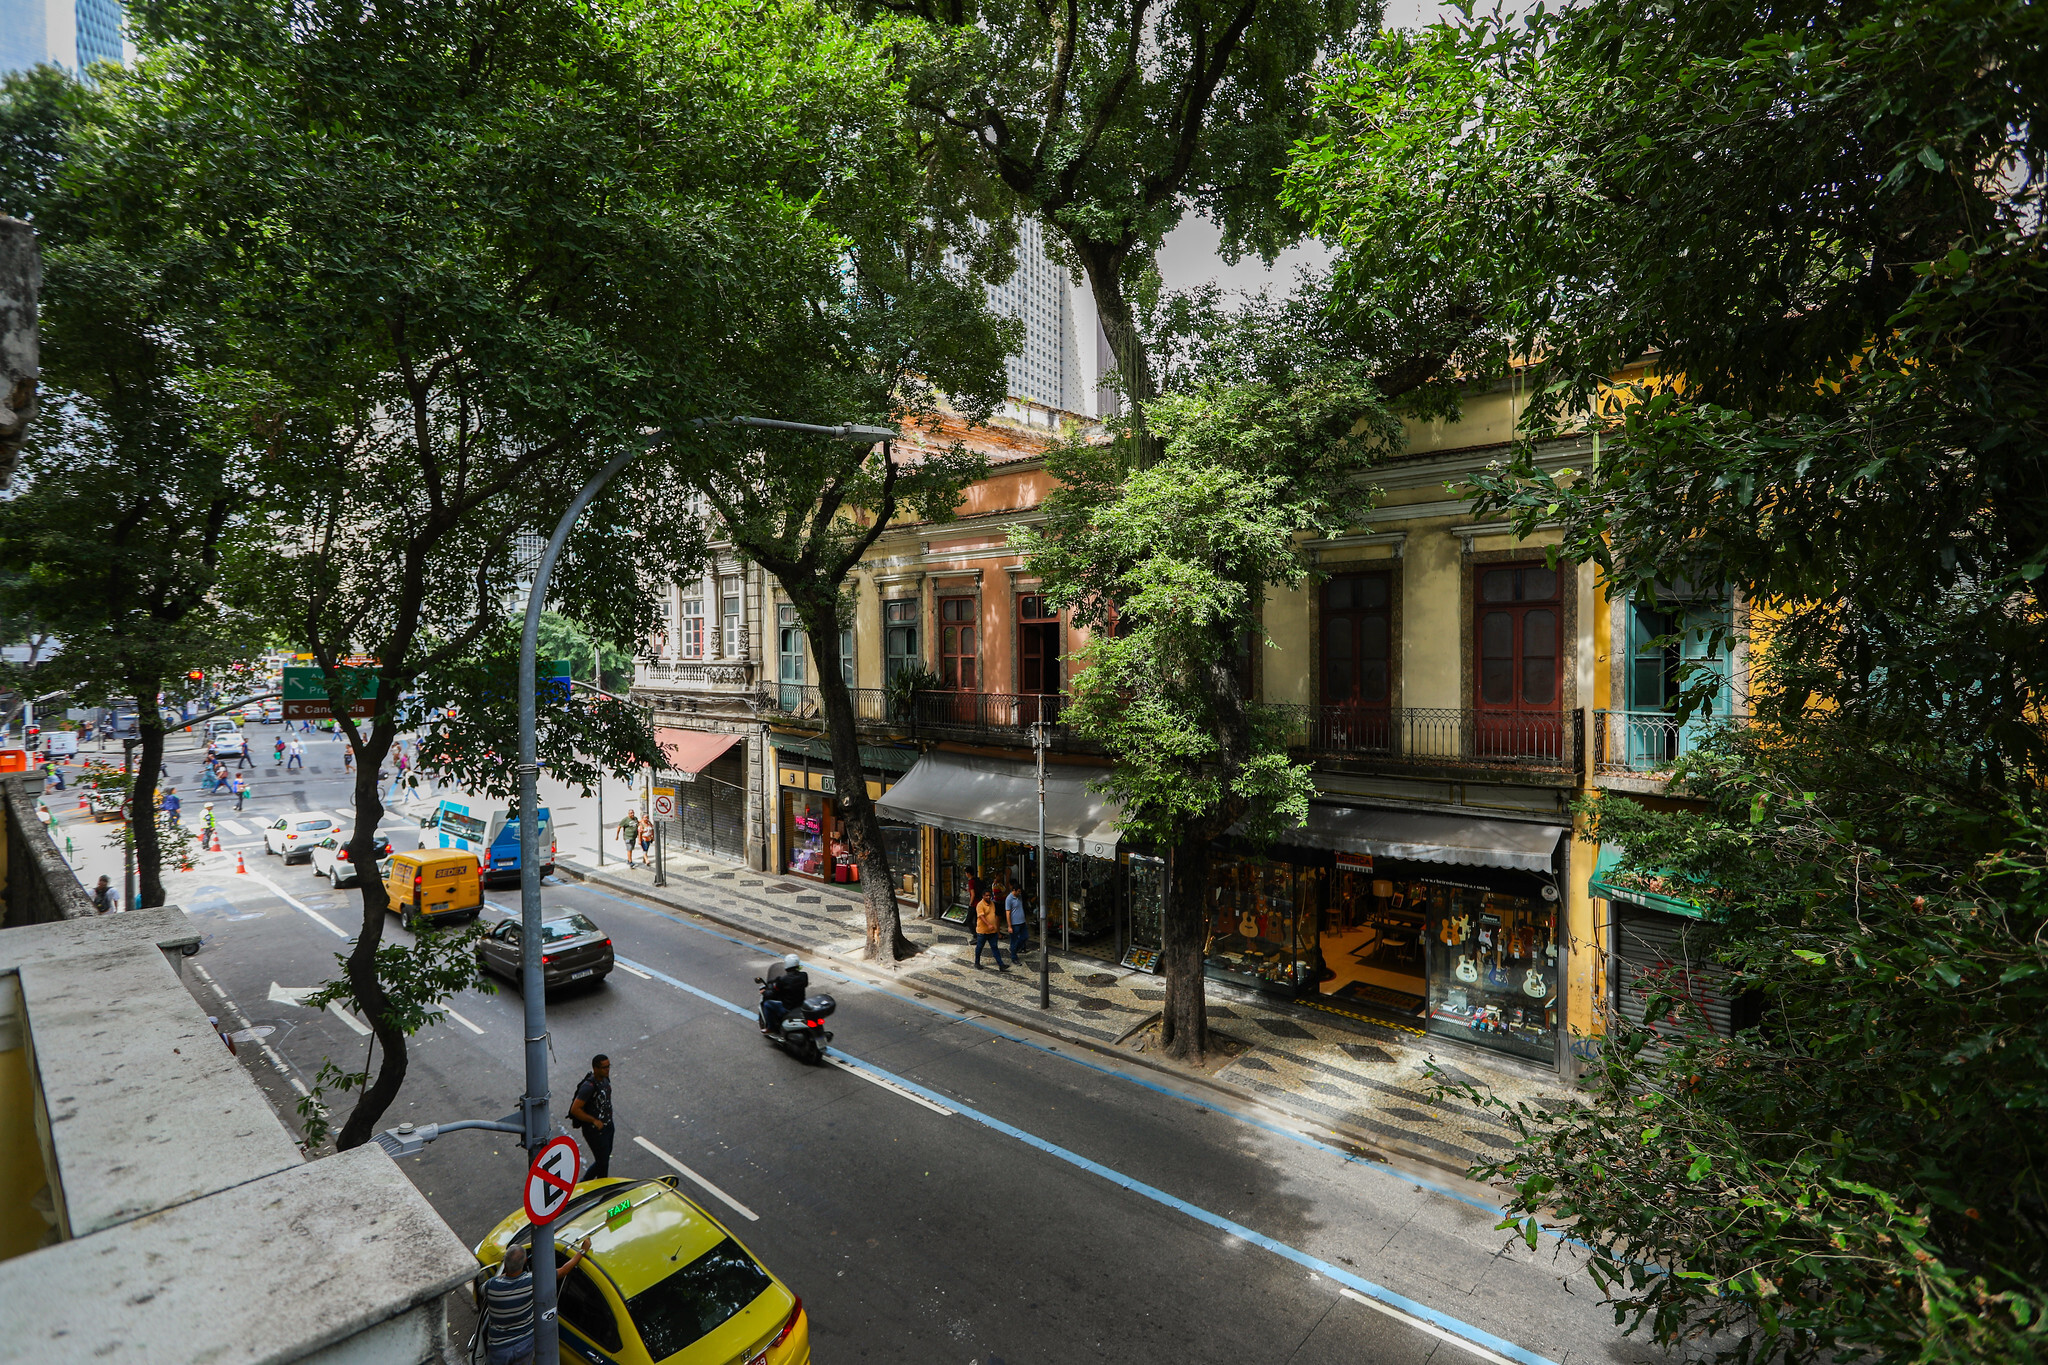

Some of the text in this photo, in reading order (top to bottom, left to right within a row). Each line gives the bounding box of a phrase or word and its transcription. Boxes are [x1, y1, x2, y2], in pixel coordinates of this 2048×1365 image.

[437, 867, 467, 877] SEDEX
[542, 1151, 563, 1208] E
[607, 1199, 631, 1217] TAXI
